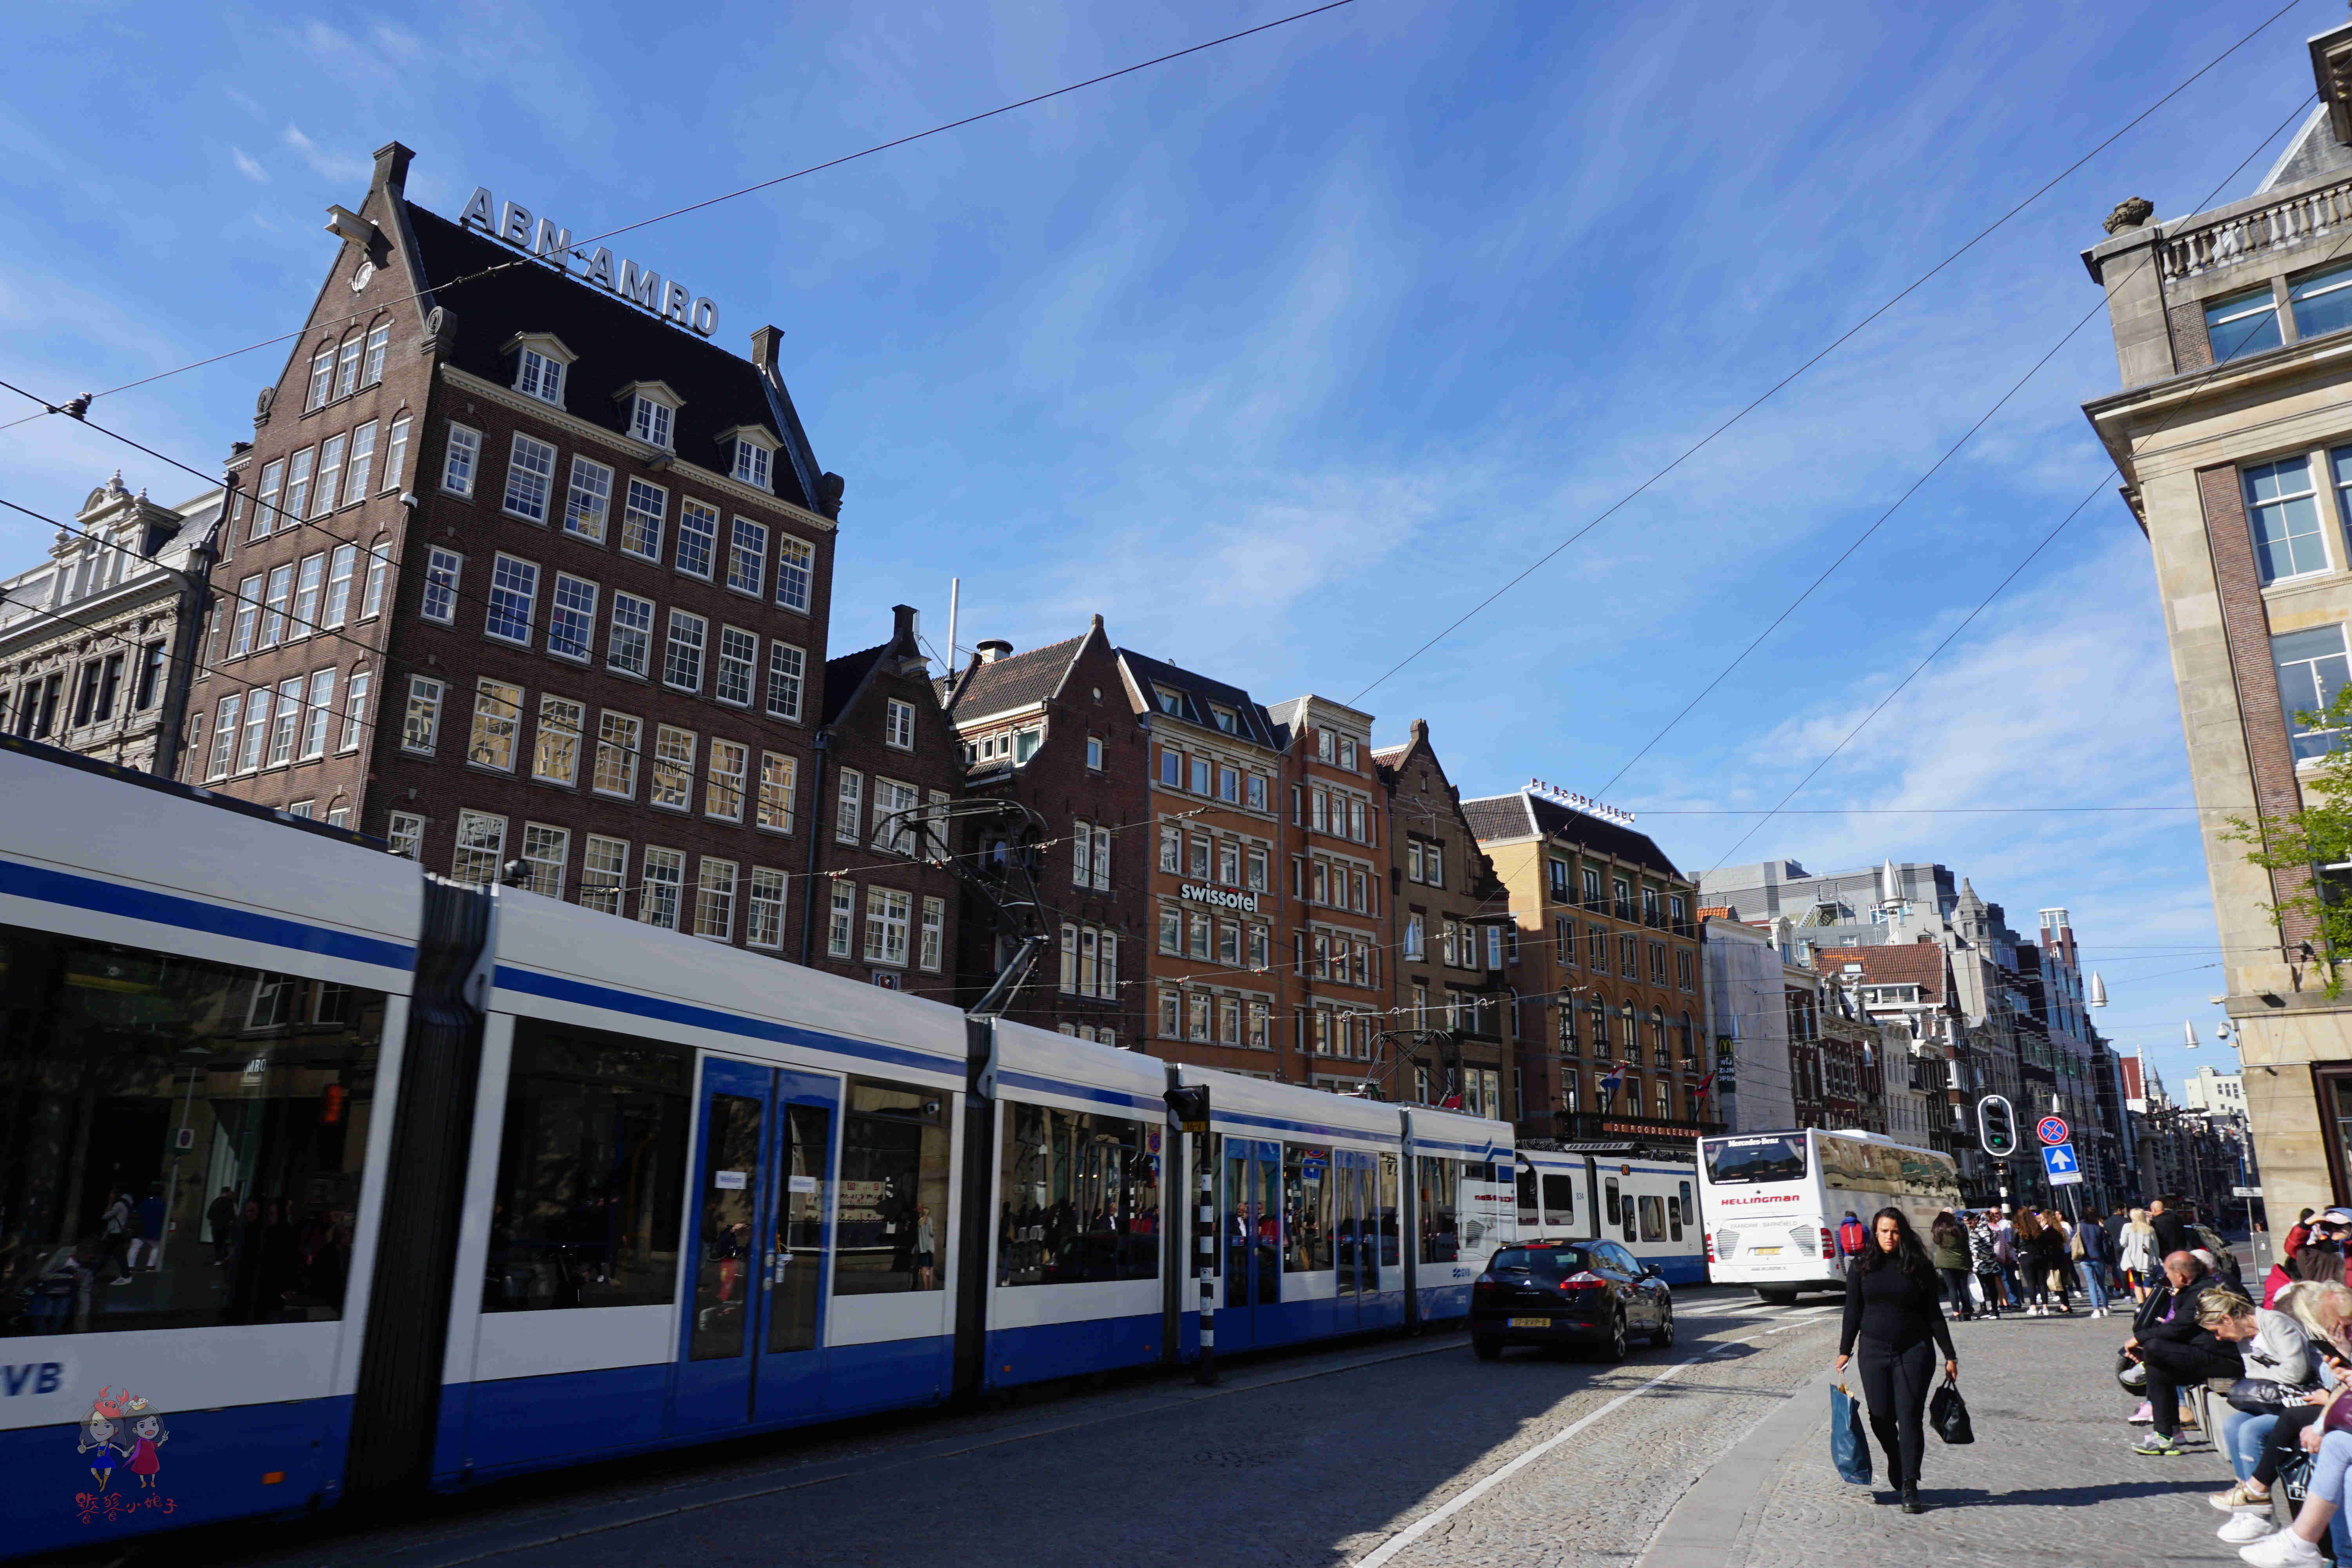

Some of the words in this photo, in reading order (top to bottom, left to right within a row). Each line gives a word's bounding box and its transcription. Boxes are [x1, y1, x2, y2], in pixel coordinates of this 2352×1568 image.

[458, 186, 572, 268] ABN
[584, 247, 719, 336] AMRO
[1530, 777, 1546, 791] DE
[1552, 786, 1593, 808] ROODE
[1614, 1123, 1625, 1132] DE
[1630, 1125, 1662, 1135] ROODE
[1666, 1128, 1695, 1137] LEEUW
[1728, 1138, 1780, 1148] Mercedes-Benz
[0, 1361, 64, 1397] VB
